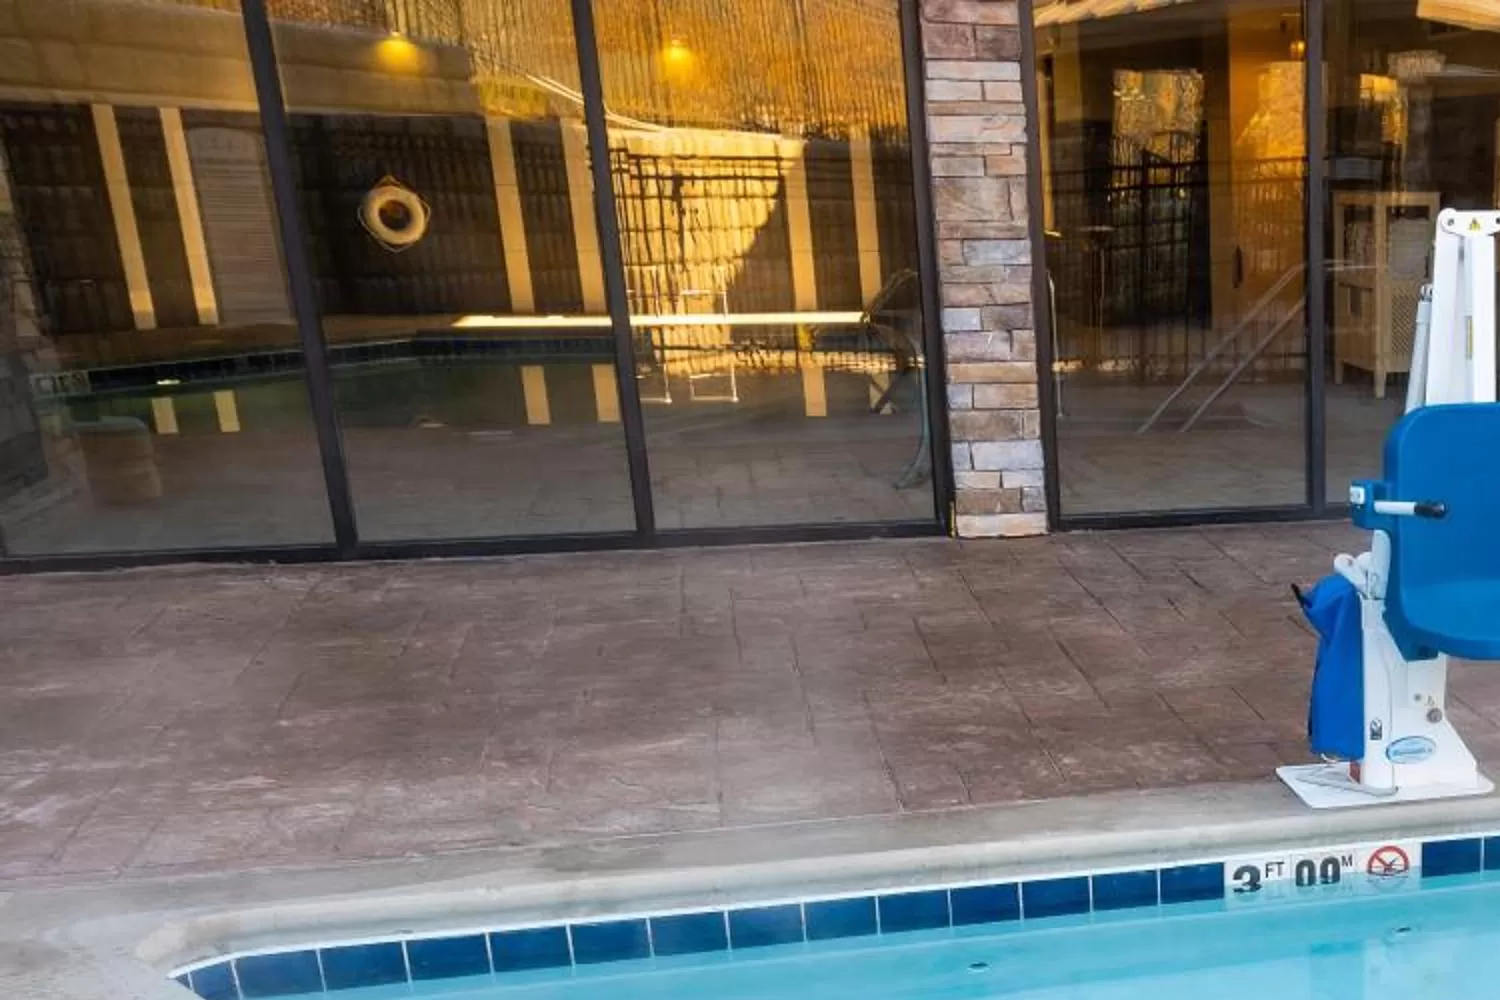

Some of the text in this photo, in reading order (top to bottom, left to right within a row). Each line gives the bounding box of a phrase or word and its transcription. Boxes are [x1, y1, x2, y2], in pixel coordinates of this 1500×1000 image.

[1233, 864, 1262, 893] 3
[1265, 861, 1284, 878] FT
[1341, 854, 1353, 867] M
